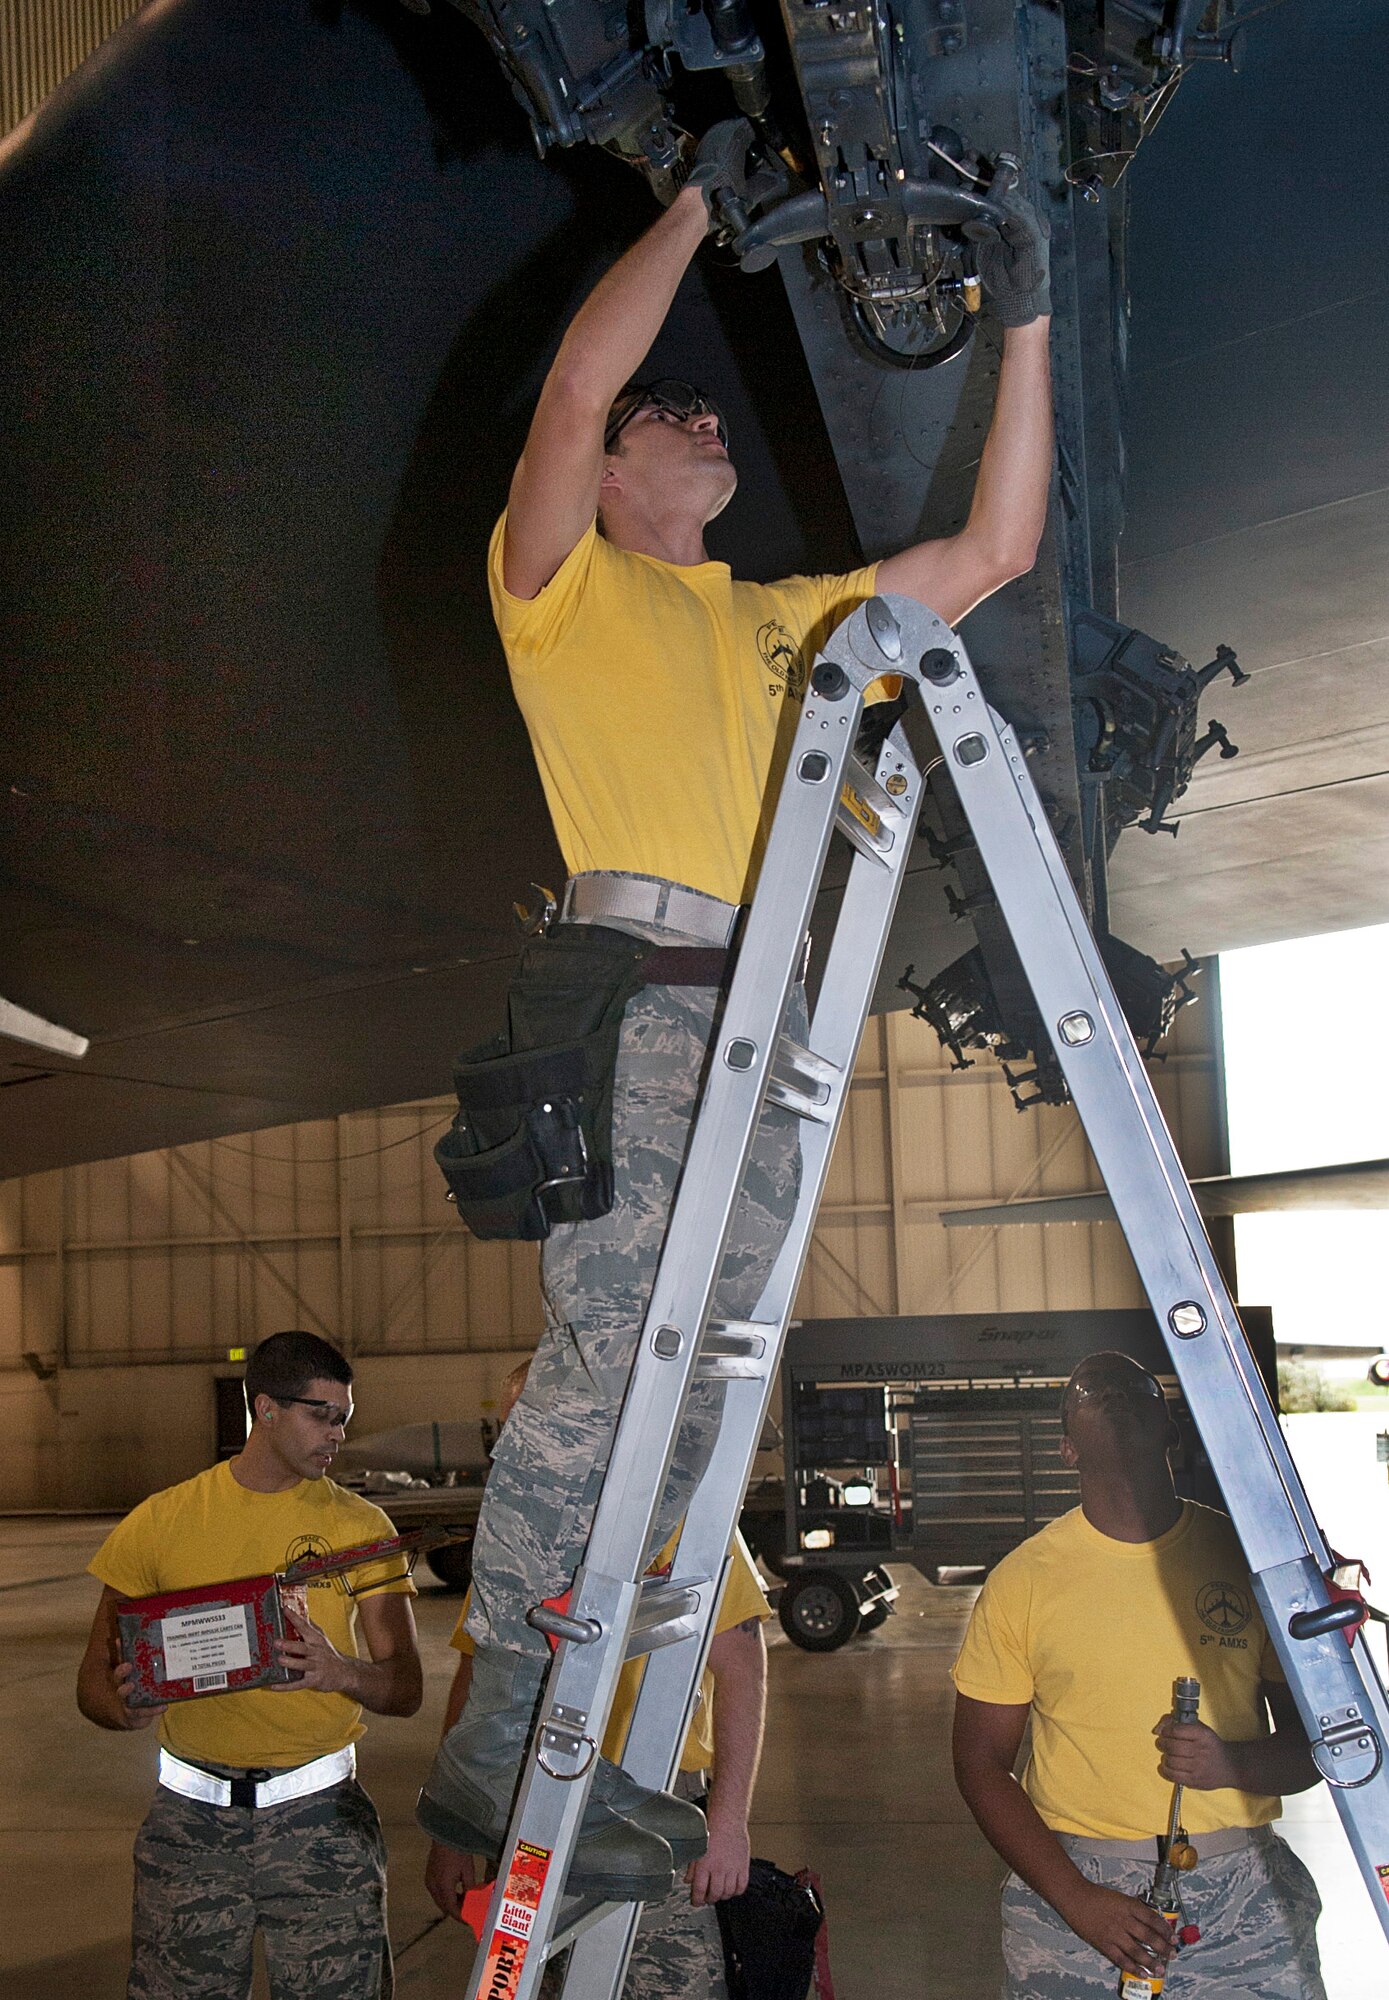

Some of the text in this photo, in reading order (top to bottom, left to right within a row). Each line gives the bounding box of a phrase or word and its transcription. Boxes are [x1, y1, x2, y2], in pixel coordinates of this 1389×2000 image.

[771, 664, 785, 677] OLD
[768, 684, 785, 697] 5th
[840, 1363, 947, 1378] MPASWOM23
[1200, 1634, 1248, 1649] 5th AMXS
[520, 1844, 548, 1858] CAUTION
[504, 1903, 533, 1923] Little
[501, 1914, 531, 1933] Giant
